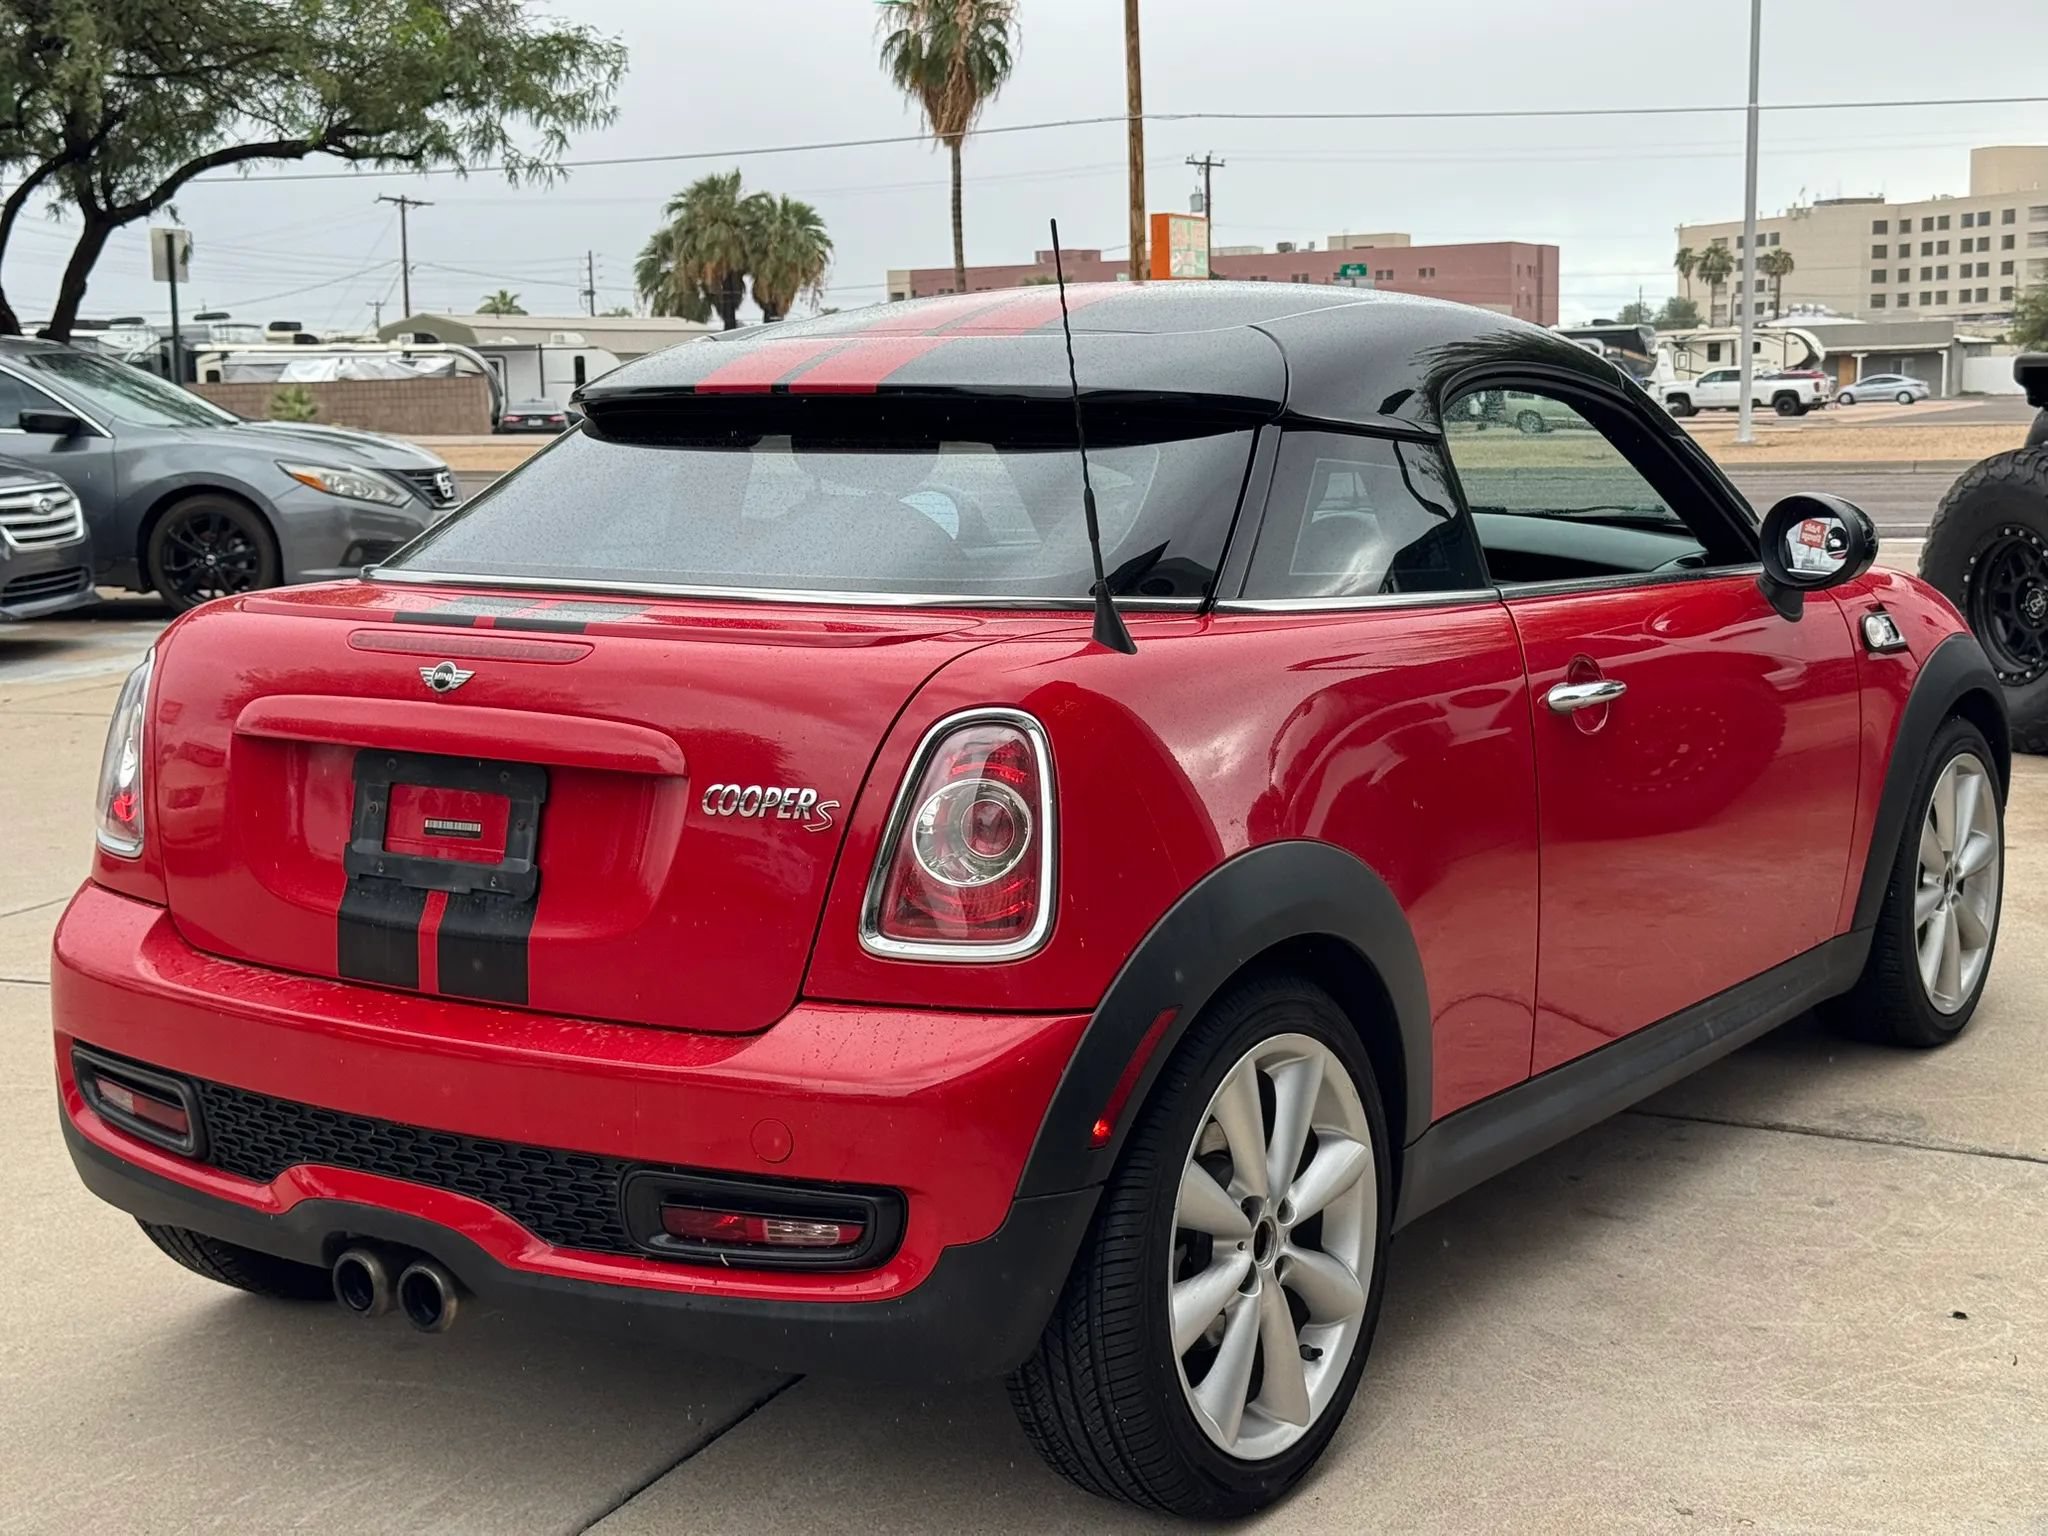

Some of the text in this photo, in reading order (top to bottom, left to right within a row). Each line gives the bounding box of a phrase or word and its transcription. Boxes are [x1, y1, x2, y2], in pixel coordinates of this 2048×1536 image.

[434, 672, 453, 681] MINI
[702, 784, 840, 832] COOPER S
